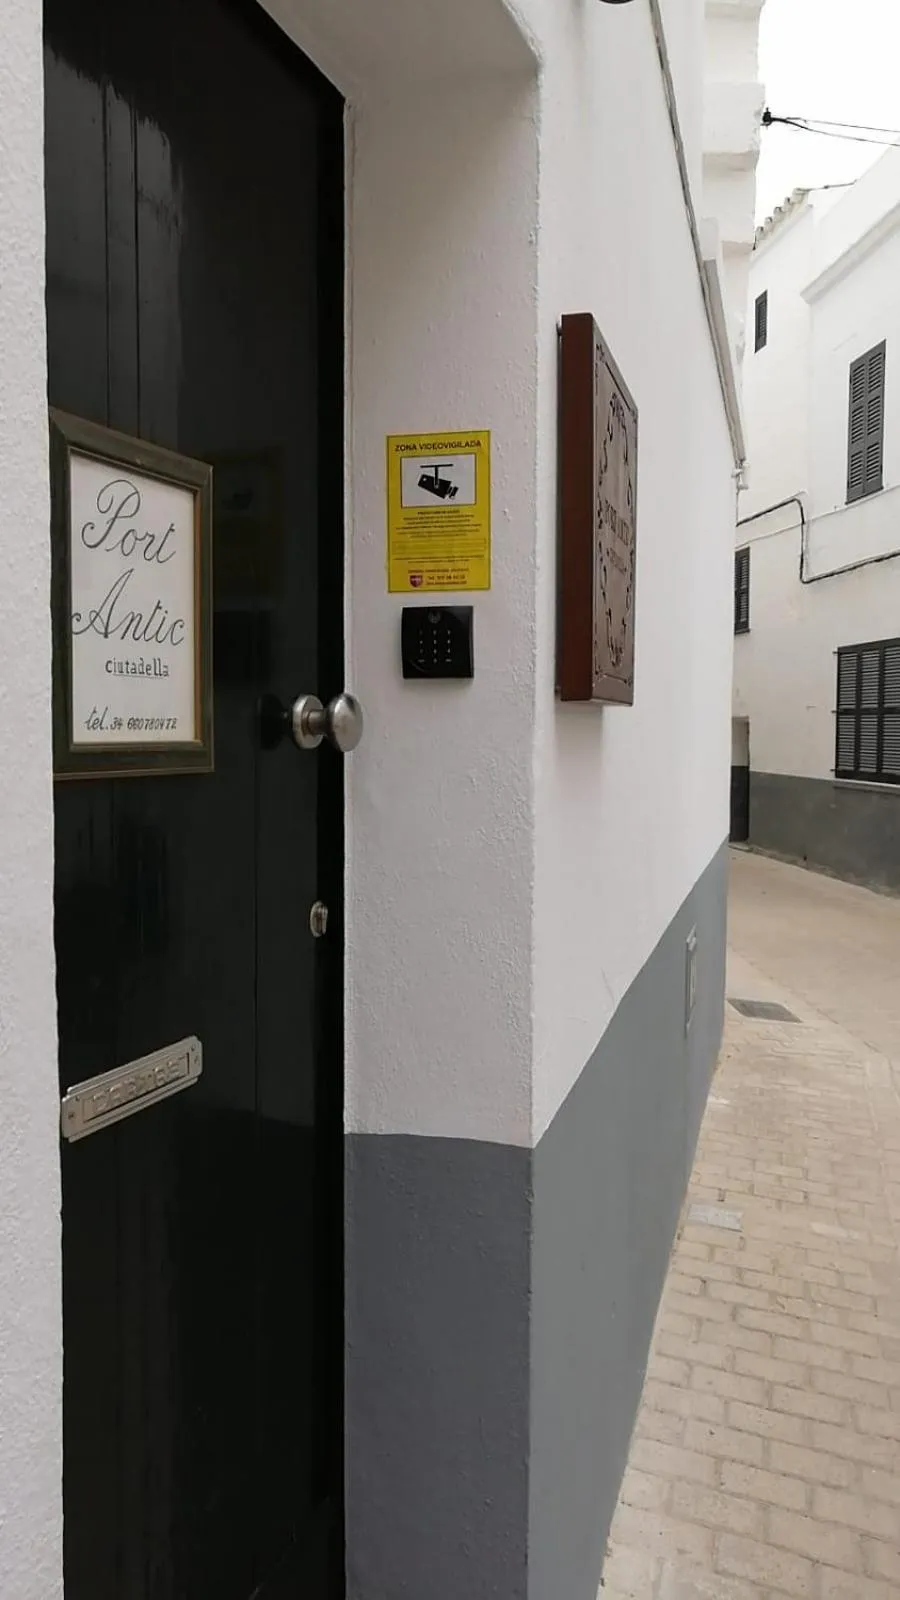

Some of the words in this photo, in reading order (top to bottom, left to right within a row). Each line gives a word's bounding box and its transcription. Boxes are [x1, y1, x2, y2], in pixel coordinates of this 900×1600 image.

[395, 443, 417, 452] ZONA
[419, 439, 482, 450] VIDEOVIGILADA
[81, 479, 176, 564] Port
[71, 568, 185, 646] Antic
